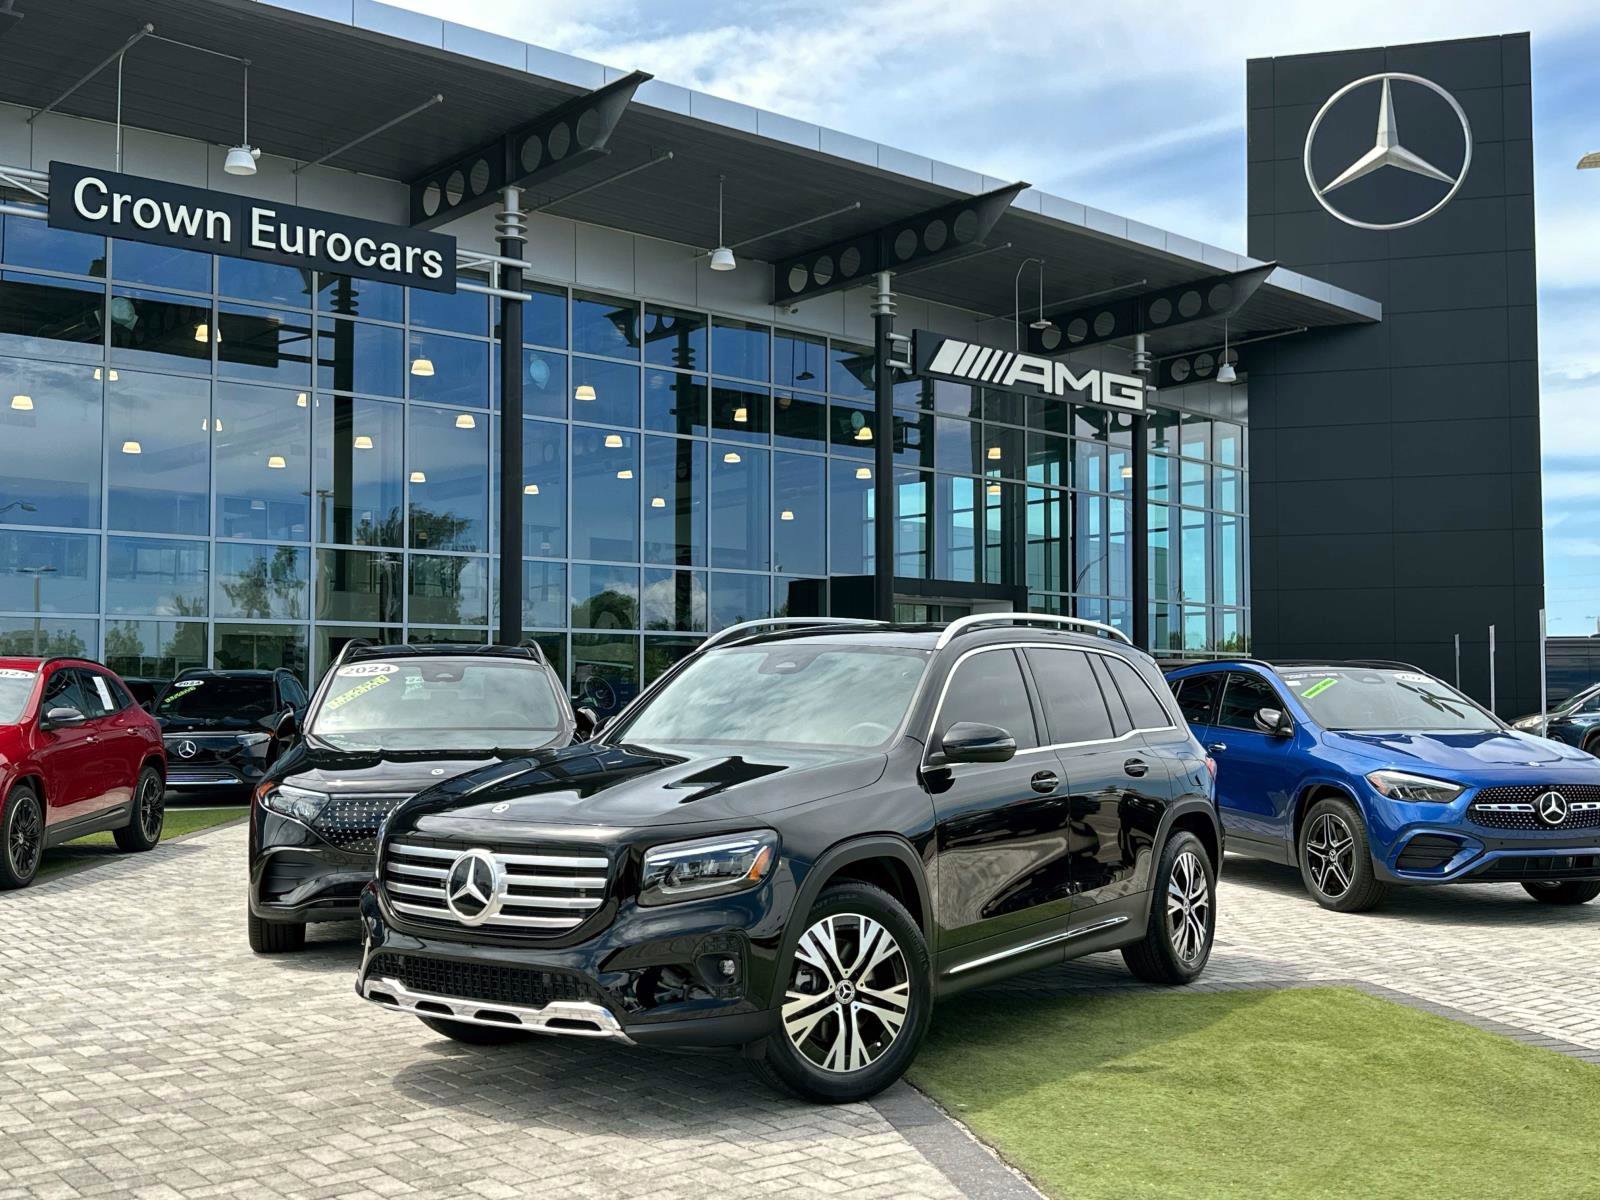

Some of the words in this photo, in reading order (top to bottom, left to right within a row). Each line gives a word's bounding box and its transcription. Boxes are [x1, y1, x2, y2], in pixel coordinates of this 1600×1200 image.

[73, 176, 232, 242] Crown
[250, 206, 444, 279] Eurocars
[1002, 353, 1144, 411] AMG
[343, 665, 391, 675] 2024
